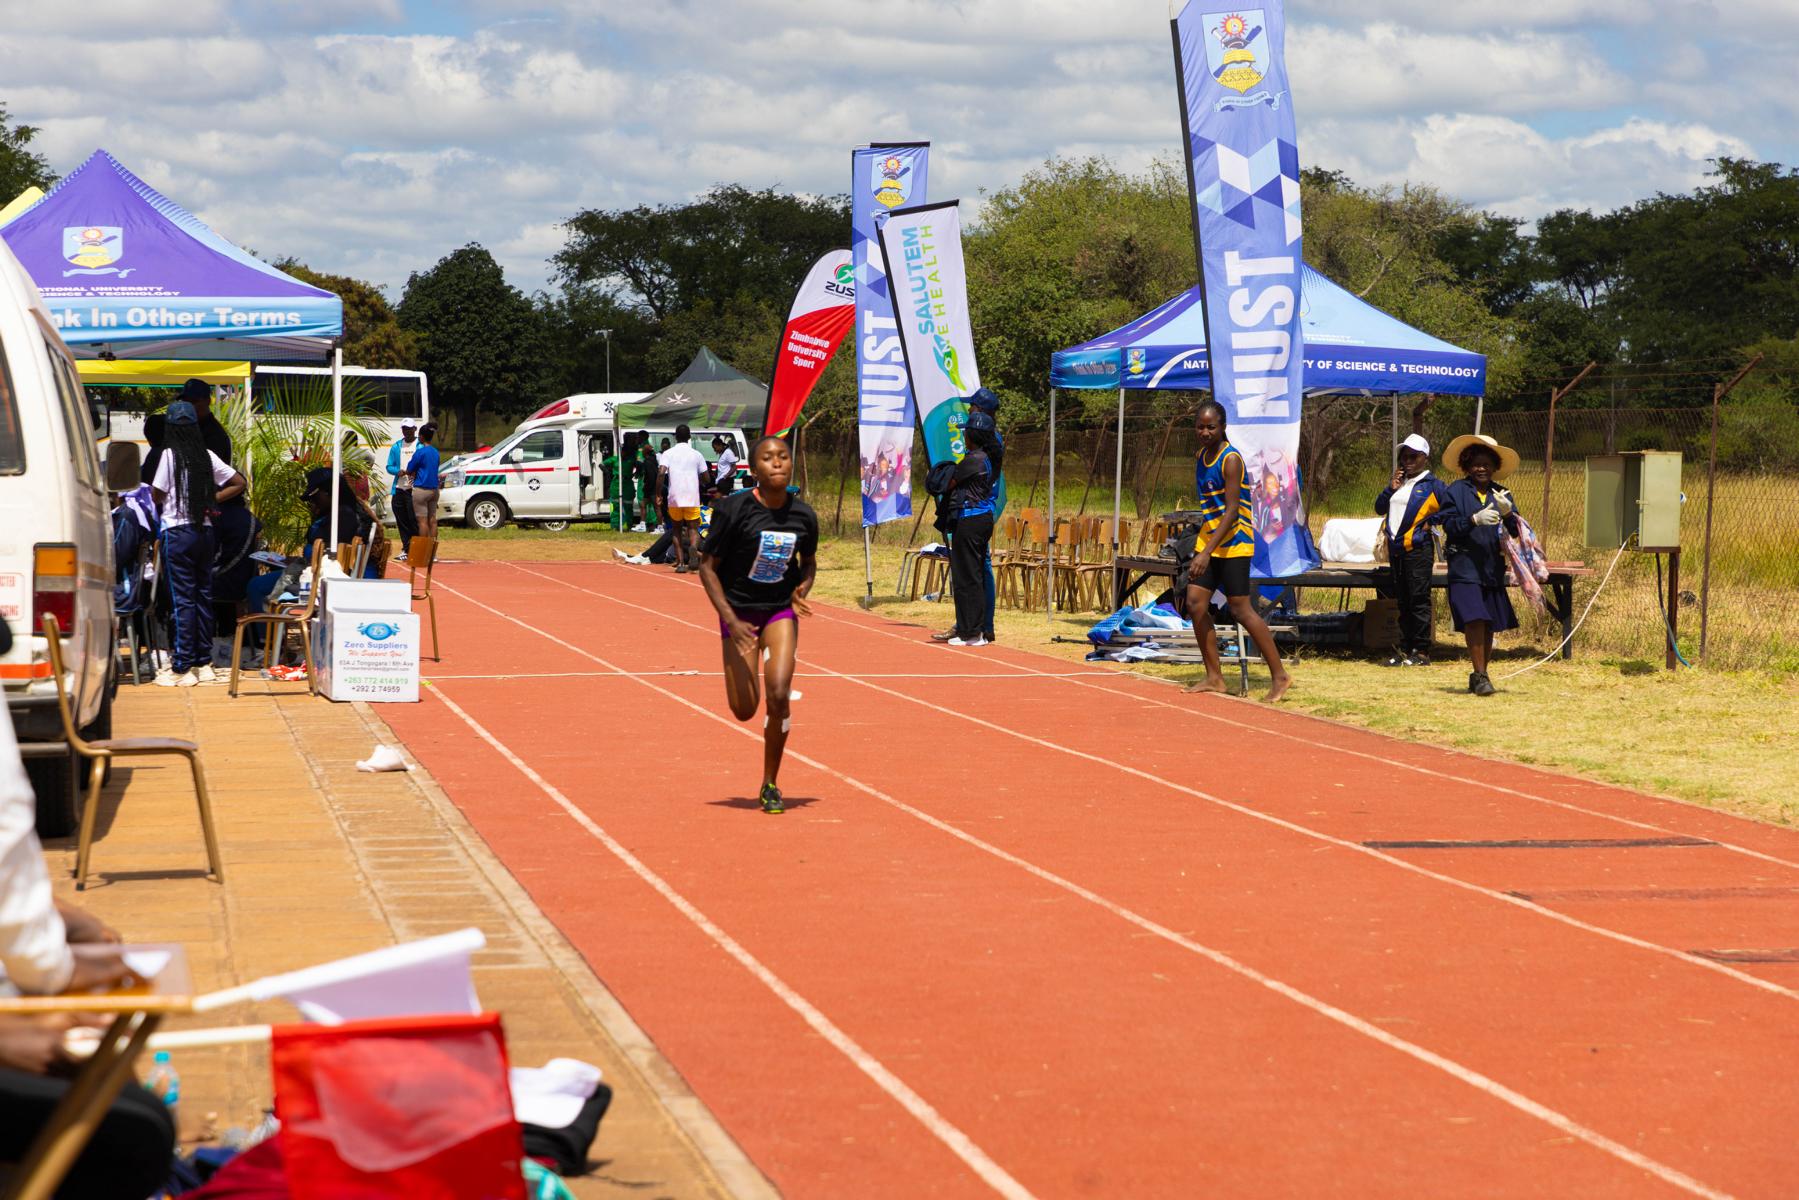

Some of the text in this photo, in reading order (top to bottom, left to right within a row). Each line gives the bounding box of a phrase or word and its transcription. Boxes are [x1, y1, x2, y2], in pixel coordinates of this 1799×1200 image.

[901, 226, 935, 336] SALUTEM
[91, 307, 118, 327] In
[127, 307, 206, 327] Other
[213, 307, 301, 326] Terms
[790, 330, 830, 349] Zimbabwe
[1224, 251, 1295, 418] NUST
[787, 341, 827, 360] University
[793, 356, 815, 369] Sport
[861, 310, 908, 423] NUST
[1317, 360, 1332, 369] OF
[1336, 361, 1386, 372] SCIENCE
[1389, 363, 1398, 372] &
[1401, 364, 1480, 378] TECHNOLOGY
[344, 641, 408, 650] Zero Suppliers
